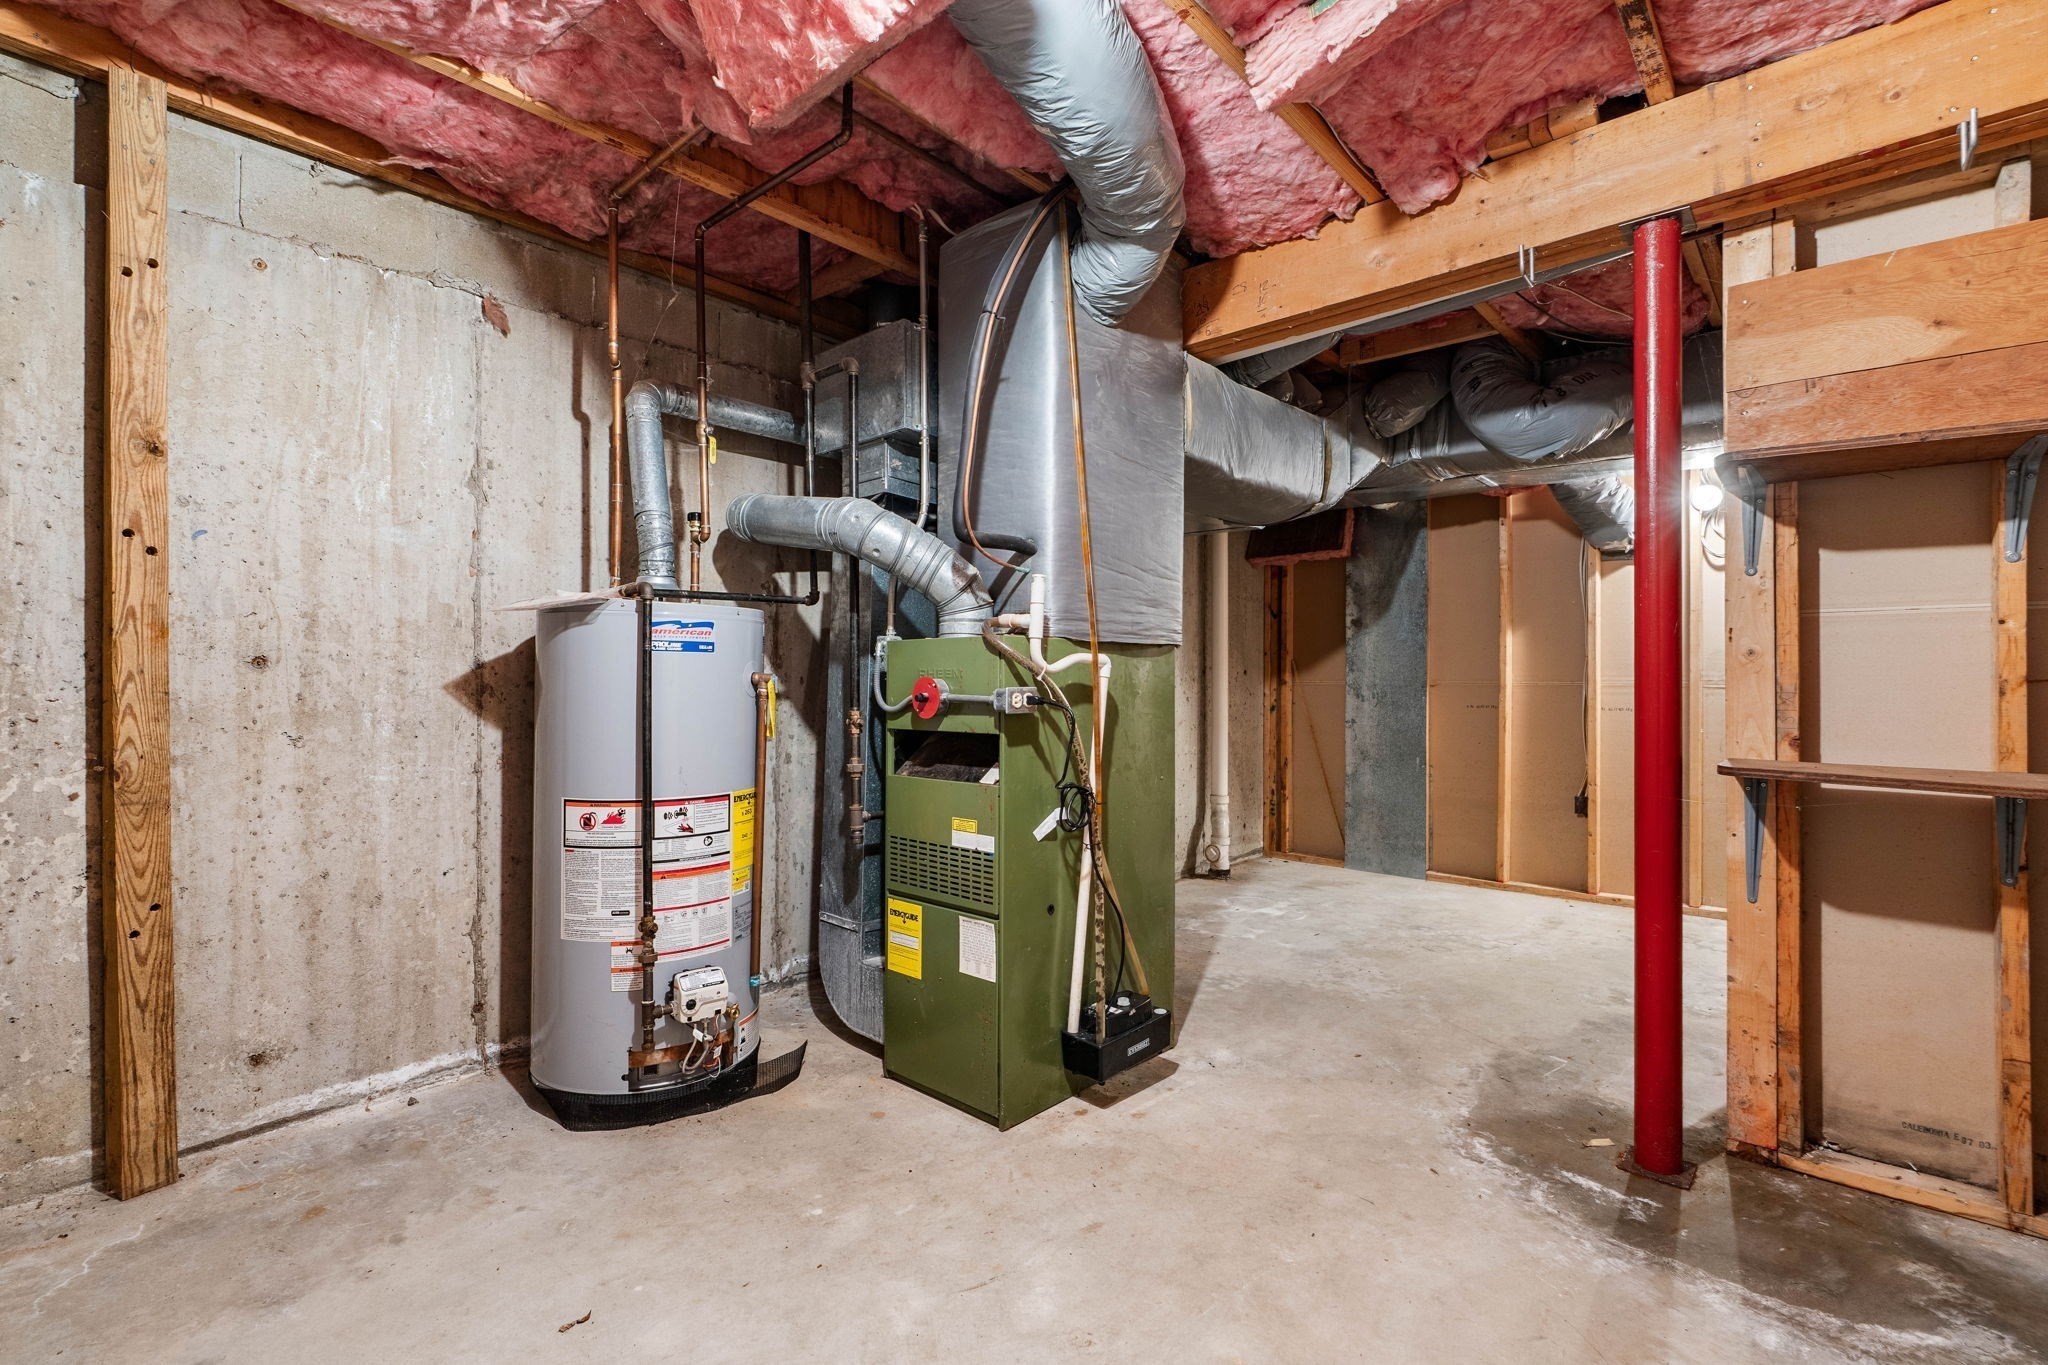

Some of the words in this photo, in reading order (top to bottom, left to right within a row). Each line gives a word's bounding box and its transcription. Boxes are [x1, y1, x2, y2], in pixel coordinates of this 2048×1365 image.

[651, 628, 712, 636] american
[919, 668, 962, 680] RHEEM
[889, 908, 919, 923] ENERGYGUIDE
